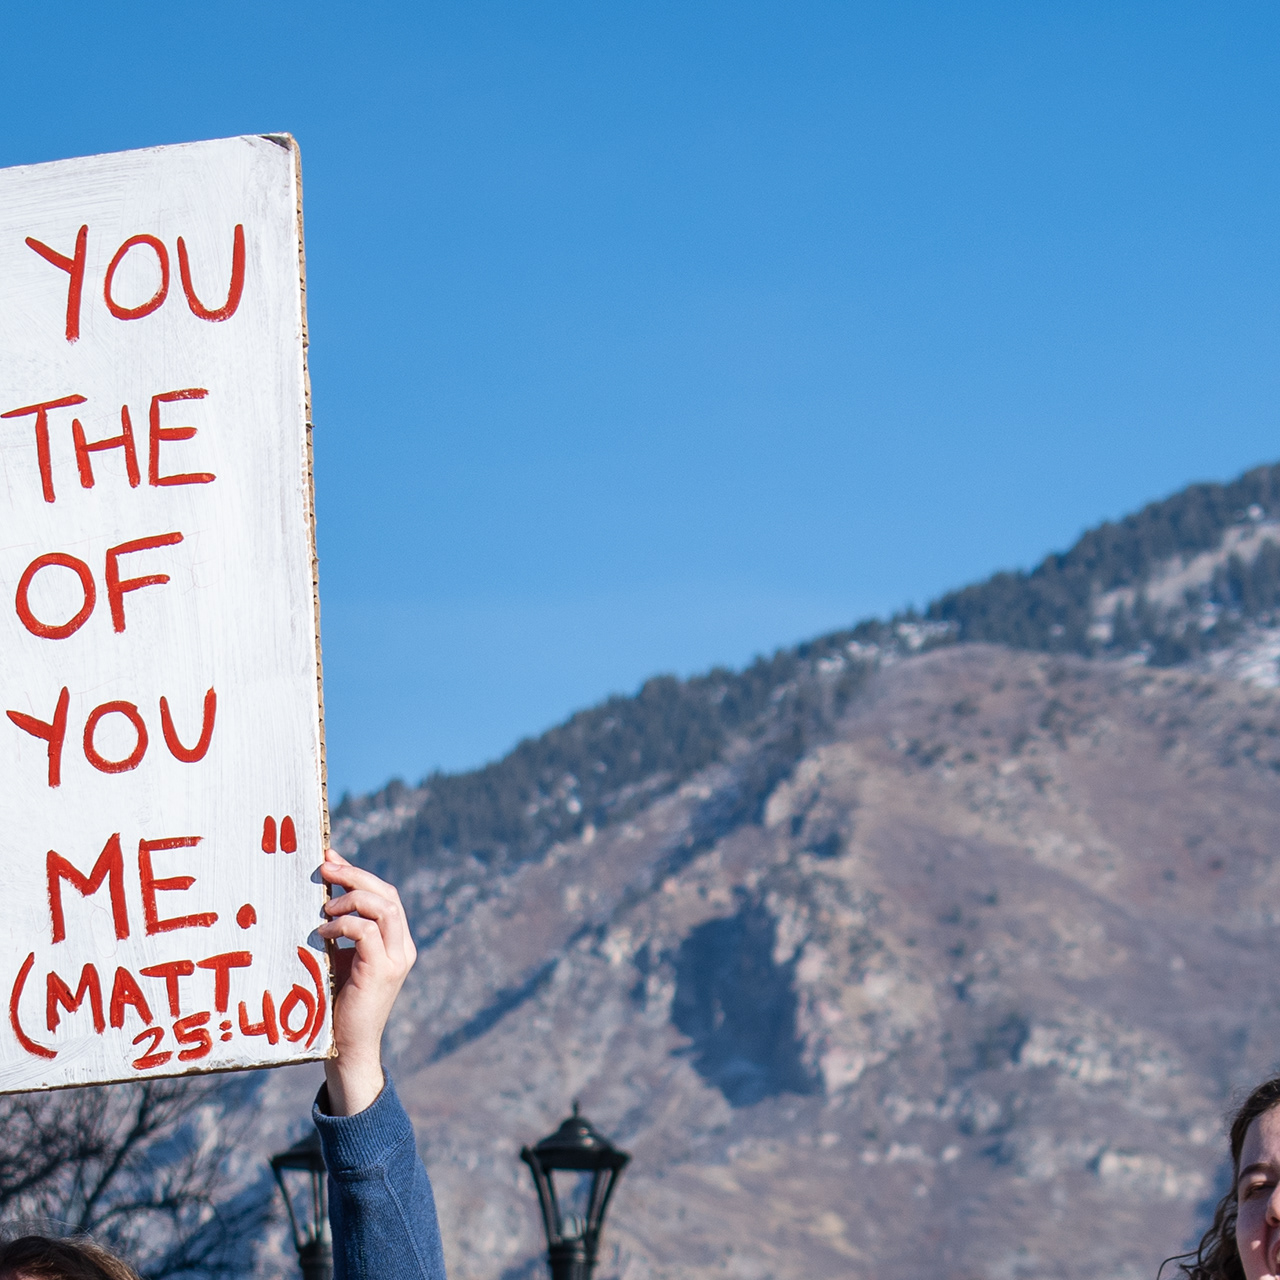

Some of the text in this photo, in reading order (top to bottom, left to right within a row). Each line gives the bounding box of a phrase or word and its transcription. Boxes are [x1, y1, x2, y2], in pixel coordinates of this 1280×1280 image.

[25, 224, 246, 341] YOU
[1, 388, 216, 503] THE
[15, 532, 184, 640] OF
[6, 686, 217, 788] YOU
[46, 815, 297, 944] ME."
[132, 946, 327, 1070] 25:40)
